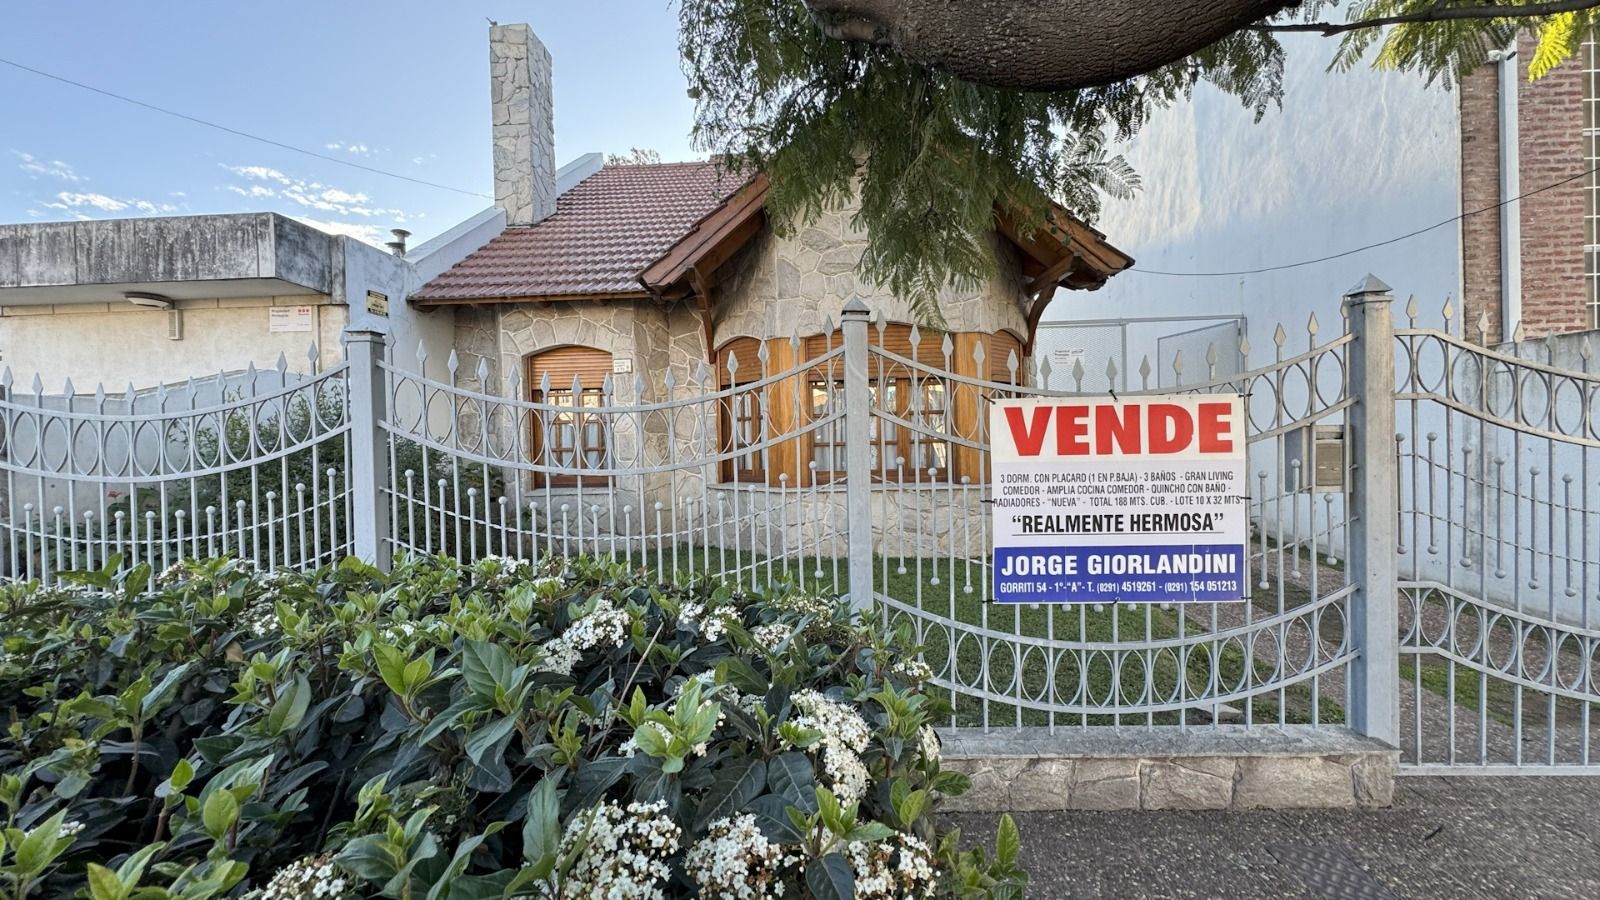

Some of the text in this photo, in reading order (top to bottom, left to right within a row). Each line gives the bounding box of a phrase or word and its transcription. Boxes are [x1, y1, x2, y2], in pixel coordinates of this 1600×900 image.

[1003, 402, 1233, 457] VENDE
[1000, 473, 1005, 484] 3
[1006, 473, 1032, 484] DORM.
[1034, 473, 1050, 483] CON
[1051, 472, 1087, 483] PLACARD
[1088, 472, 1095, 484] (1
[1099, 472, 1108, 483] EN
[1143, 472, 1149, 482] 3
[1150, 470, 1176, 482] BAÑOS
[1184, 471, 1206, 481] GRAN
[1208, 471, 1234, 481] LIVING
[1002, 485, 1040, 495] COMEDOR
[1046, 485, 1076, 495] AMPLIA
[1077, 484, 1105, 495] COCINA
[1106, 484, 1145, 494] COMEDOR
[1151, 483, 1185, 494] QUINCHO
[1187, 483, 1203, 493] CON
[1205, 481, 1226, 493] BAÑO
[993, 497, 1041, 507] RADIADORES
[1090, 497, 1113, 507] TOTAL
[1114, 496, 1128, 506] 188
[1129, 496, 1149, 506] MTS.
[1150, 496, 1168, 506] CUB.
[1175, 496, 1194, 506] LOTE
[1196, 496, 1205, 505] 10
[1206, 496, 1212, 505] X
[1213, 495, 1222, 505] 32
[1012, 513, 1224, 533] “REALMENTE HERMOSA”
[1001, 553, 1236, 576] JORGE GIORLANDINI
[1000, 582, 1035, 593] GORRITI
[1036, 582, 1047, 593] 54
[1087, 581, 1095, 592] T.
[1096, 582, 1120, 594] (0291)
[1121, 581, 1156, 592] 4519261
[1164, 581, 1188, 594] (0291)
[1189, 581, 1205, 592] 154
[1206, 580, 1237, 592] 051213
